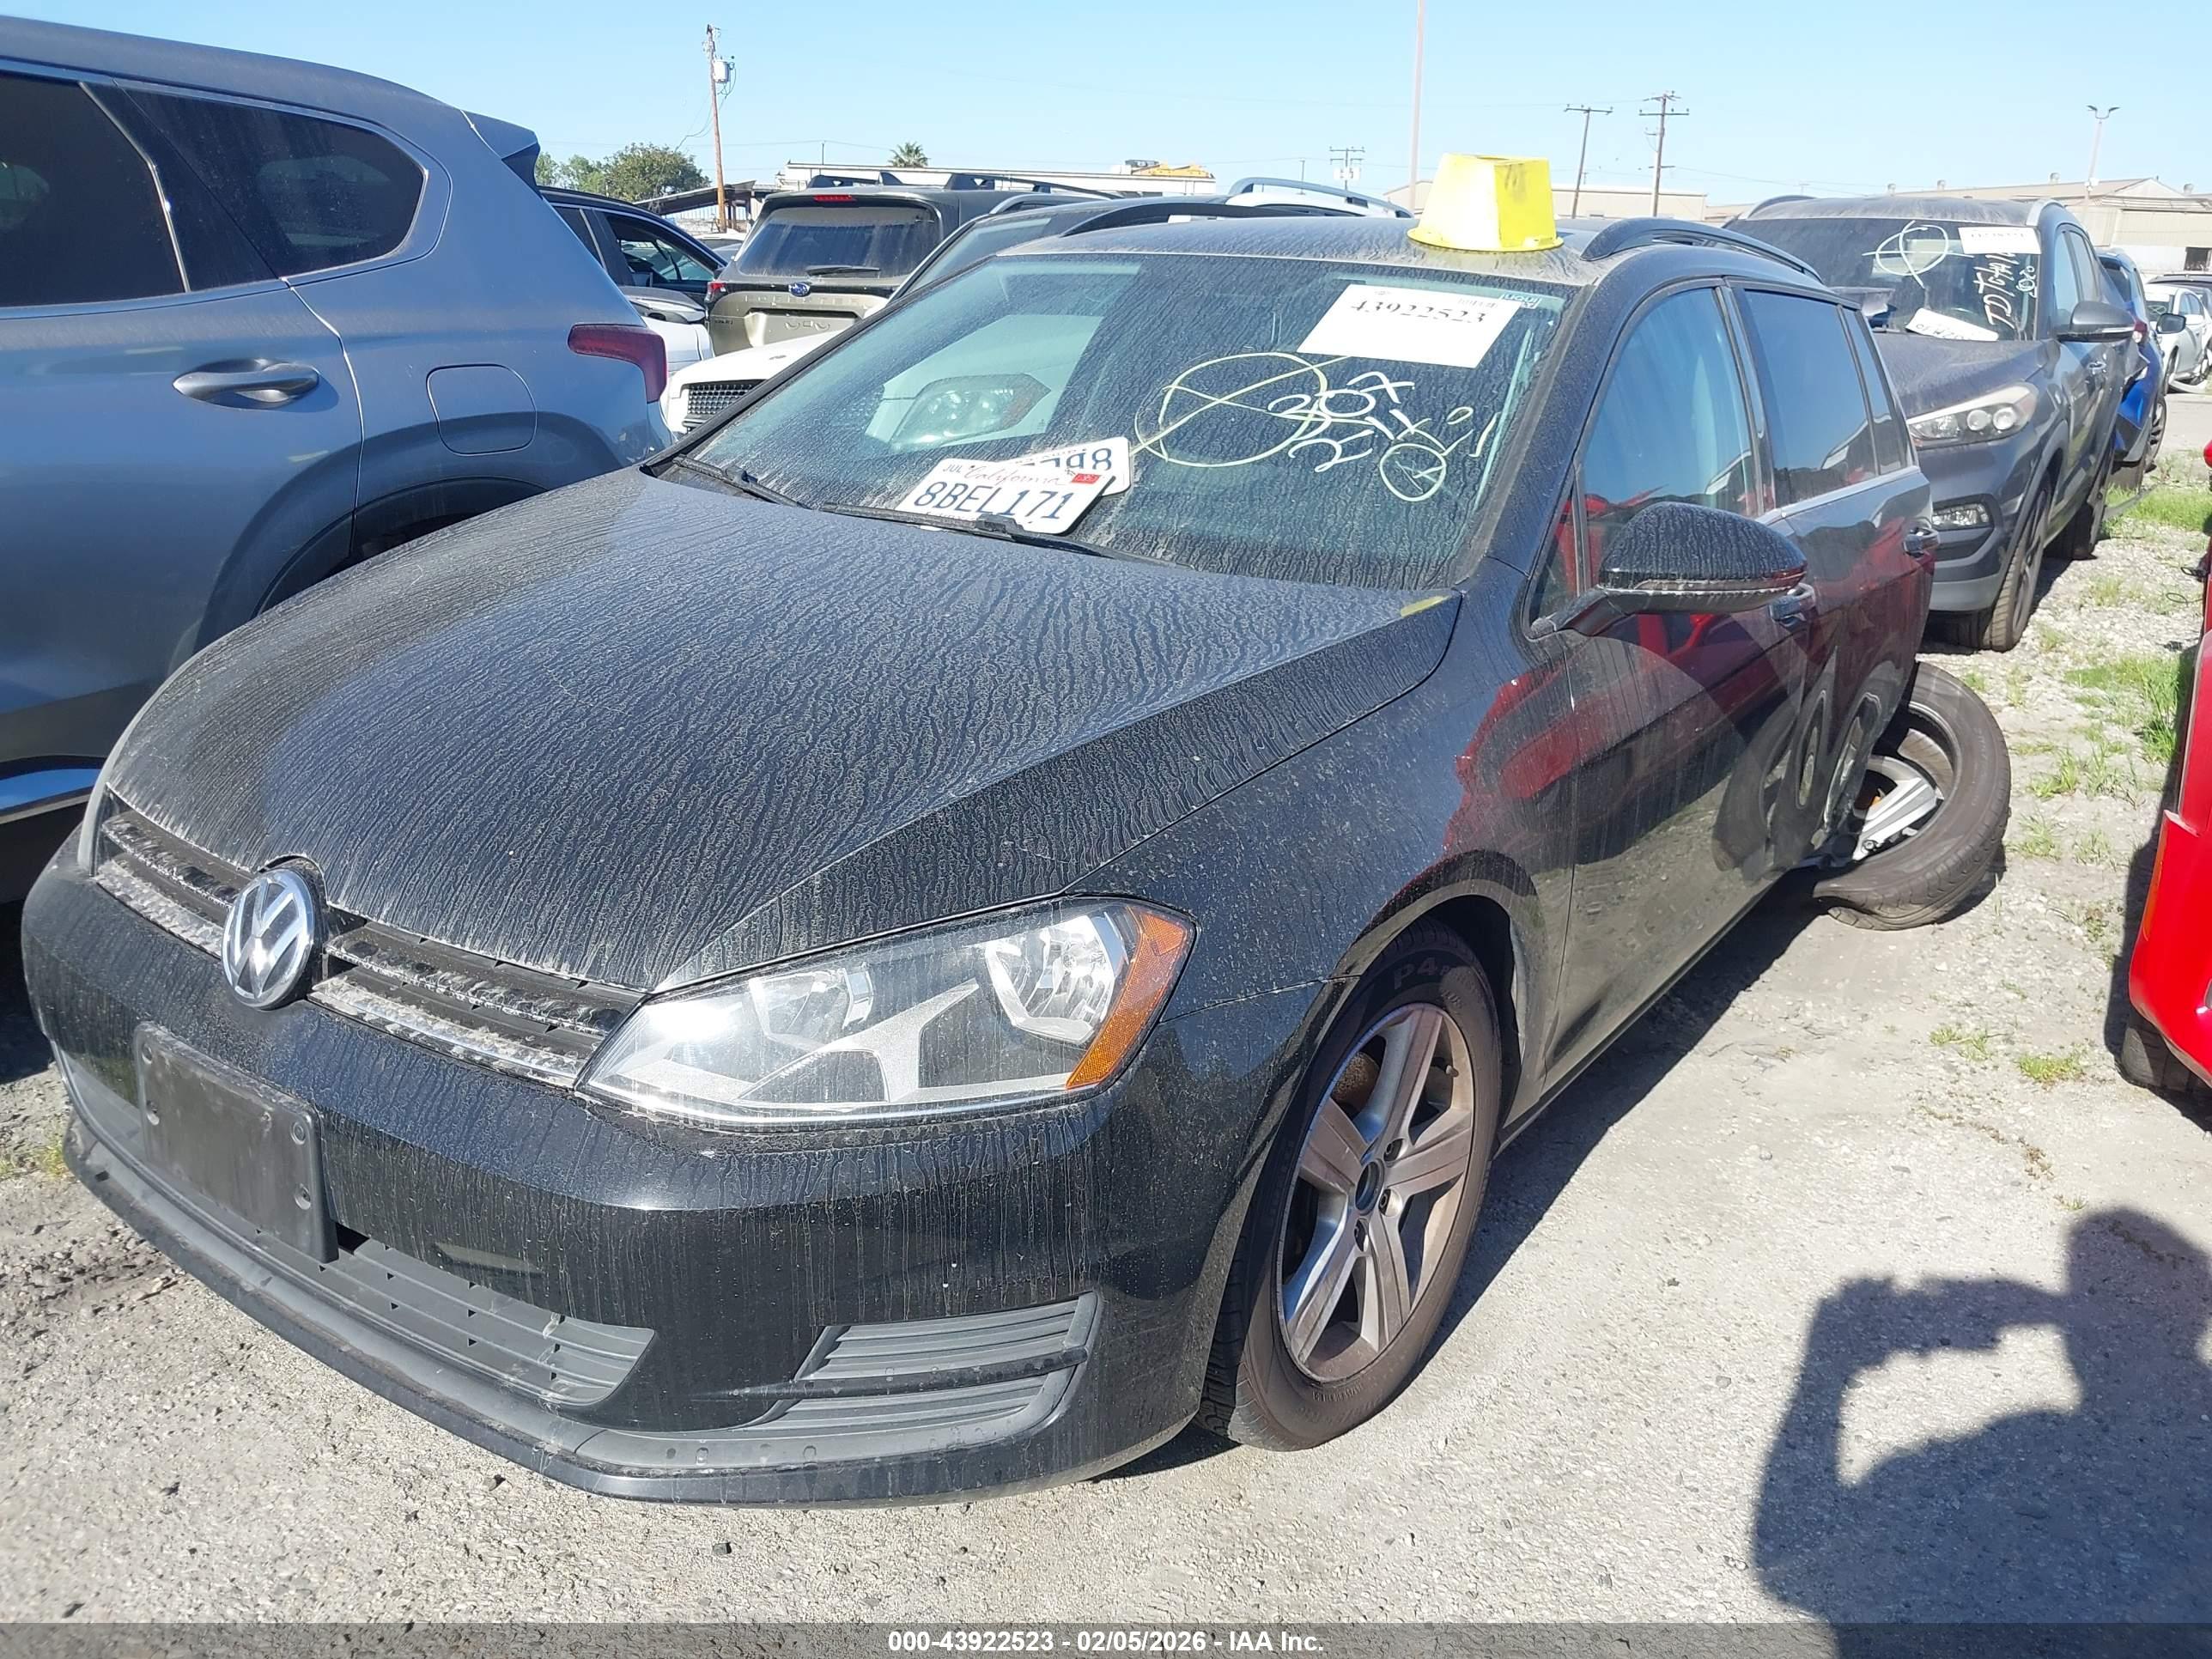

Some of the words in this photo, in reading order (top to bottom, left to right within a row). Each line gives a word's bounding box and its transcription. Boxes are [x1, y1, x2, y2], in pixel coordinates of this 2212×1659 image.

[1352, 299, 1487, 323] 43922523
[943, 464, 963, 473] JUL
[963, 465, 1065, 486] California
[914, 481, 1074, 520] 8BEL171
